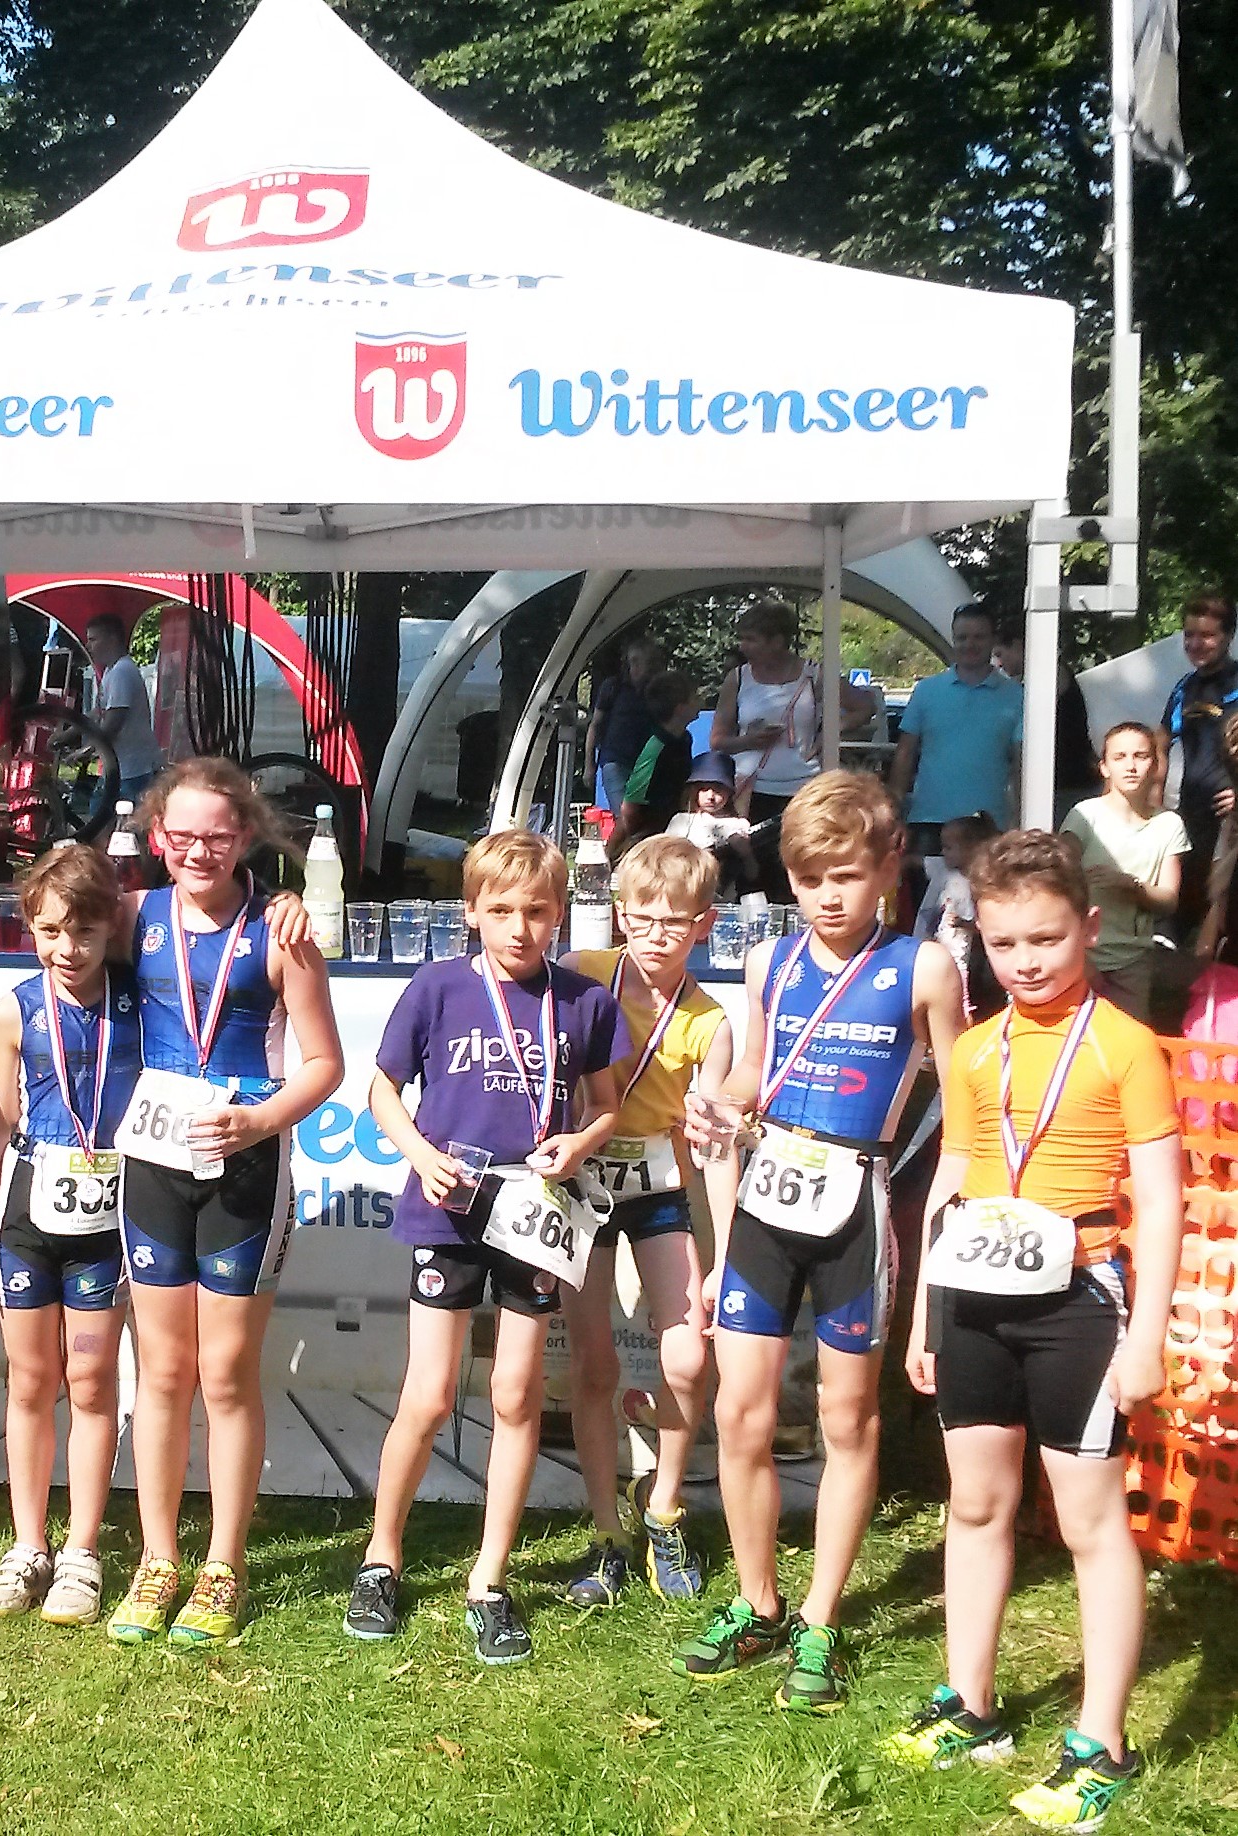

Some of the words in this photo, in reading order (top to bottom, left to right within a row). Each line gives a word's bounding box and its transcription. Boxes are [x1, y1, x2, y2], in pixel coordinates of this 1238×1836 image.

[395, 346, 428, 363] 1896
[508, 368, 988, 438] Wittenseer
[583, 1157, 651, 1191] 371
[755, 1159, 828, 1212] 361
[512, 1200, 574, 1262] 364
